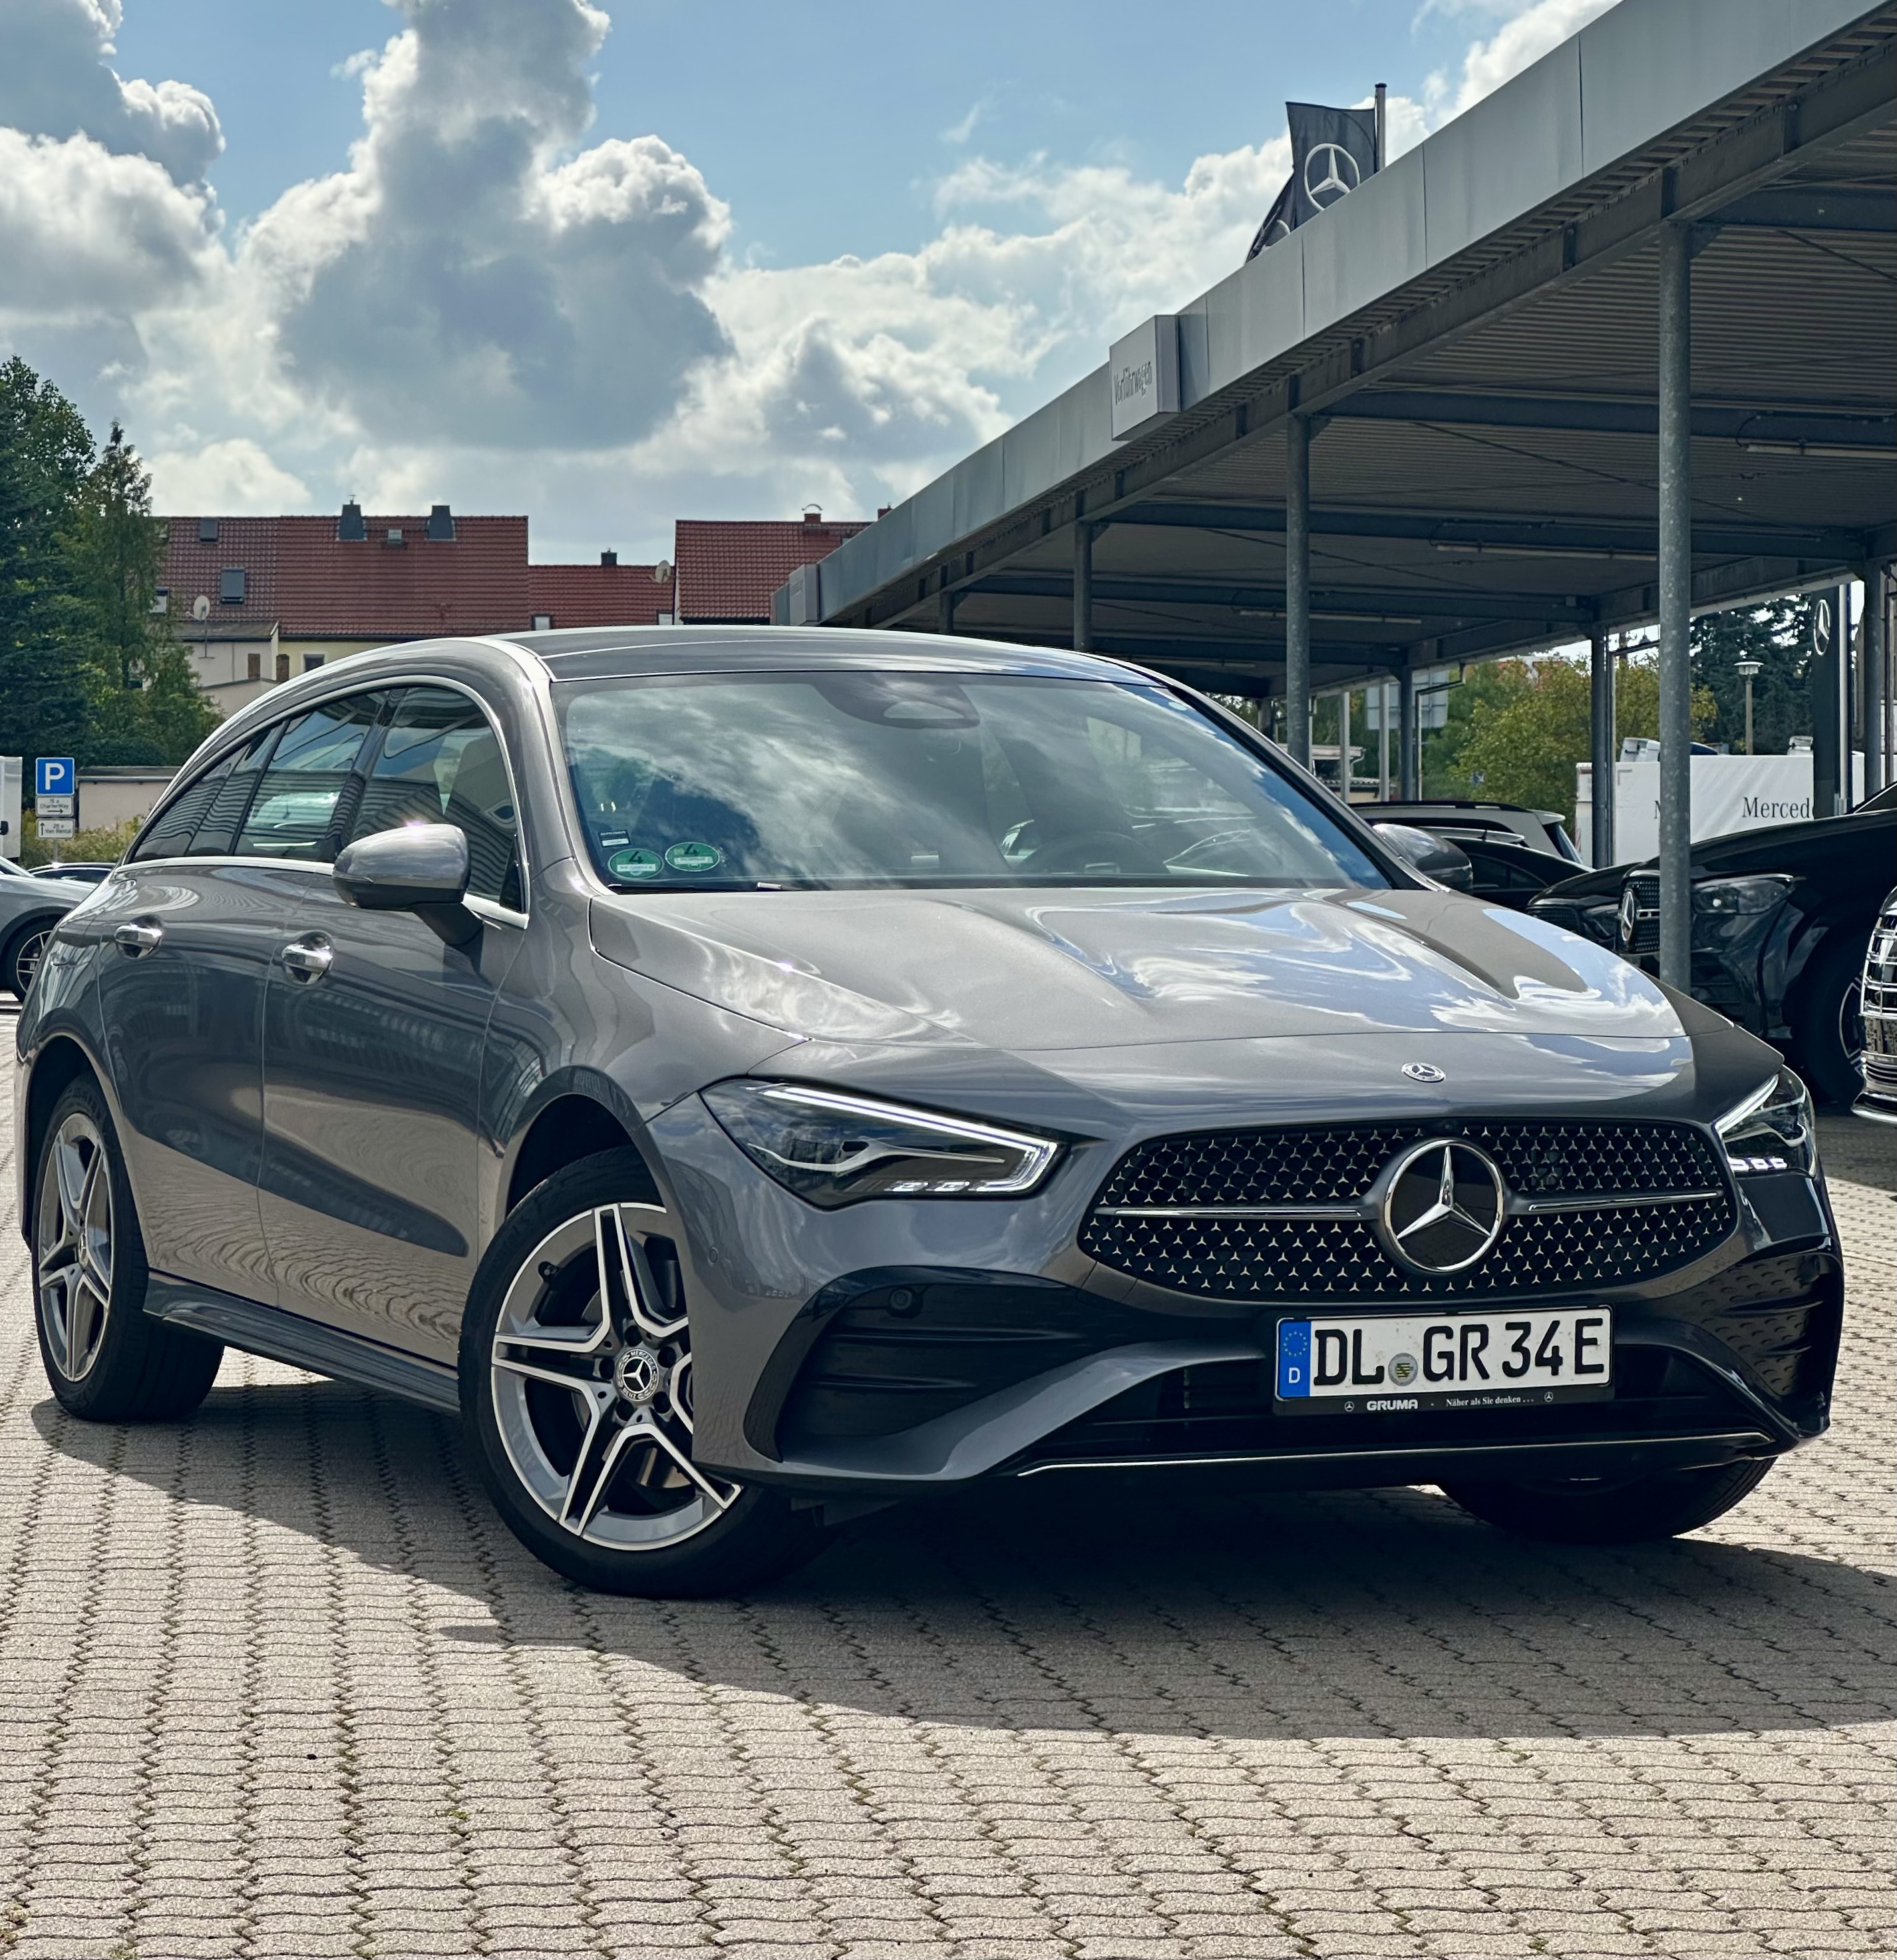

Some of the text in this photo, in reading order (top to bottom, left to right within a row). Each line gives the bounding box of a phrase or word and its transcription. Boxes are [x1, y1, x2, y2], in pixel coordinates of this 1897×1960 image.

[45, 763, 65, 790] P
[1742, 797, 1815, 819] Merced
[629, 851, 643, 864] 4
[684, 844, 698, 857] 4
[1313, 1328, 1385, 1386] DL
[1288, 1367, 1301, 1384] D
[1366, 1399, 1419, 1412] GRUMA
[1446, 1398, 1469, 1407] Näher
[1482, 1396, 1494, 1405] Sie
